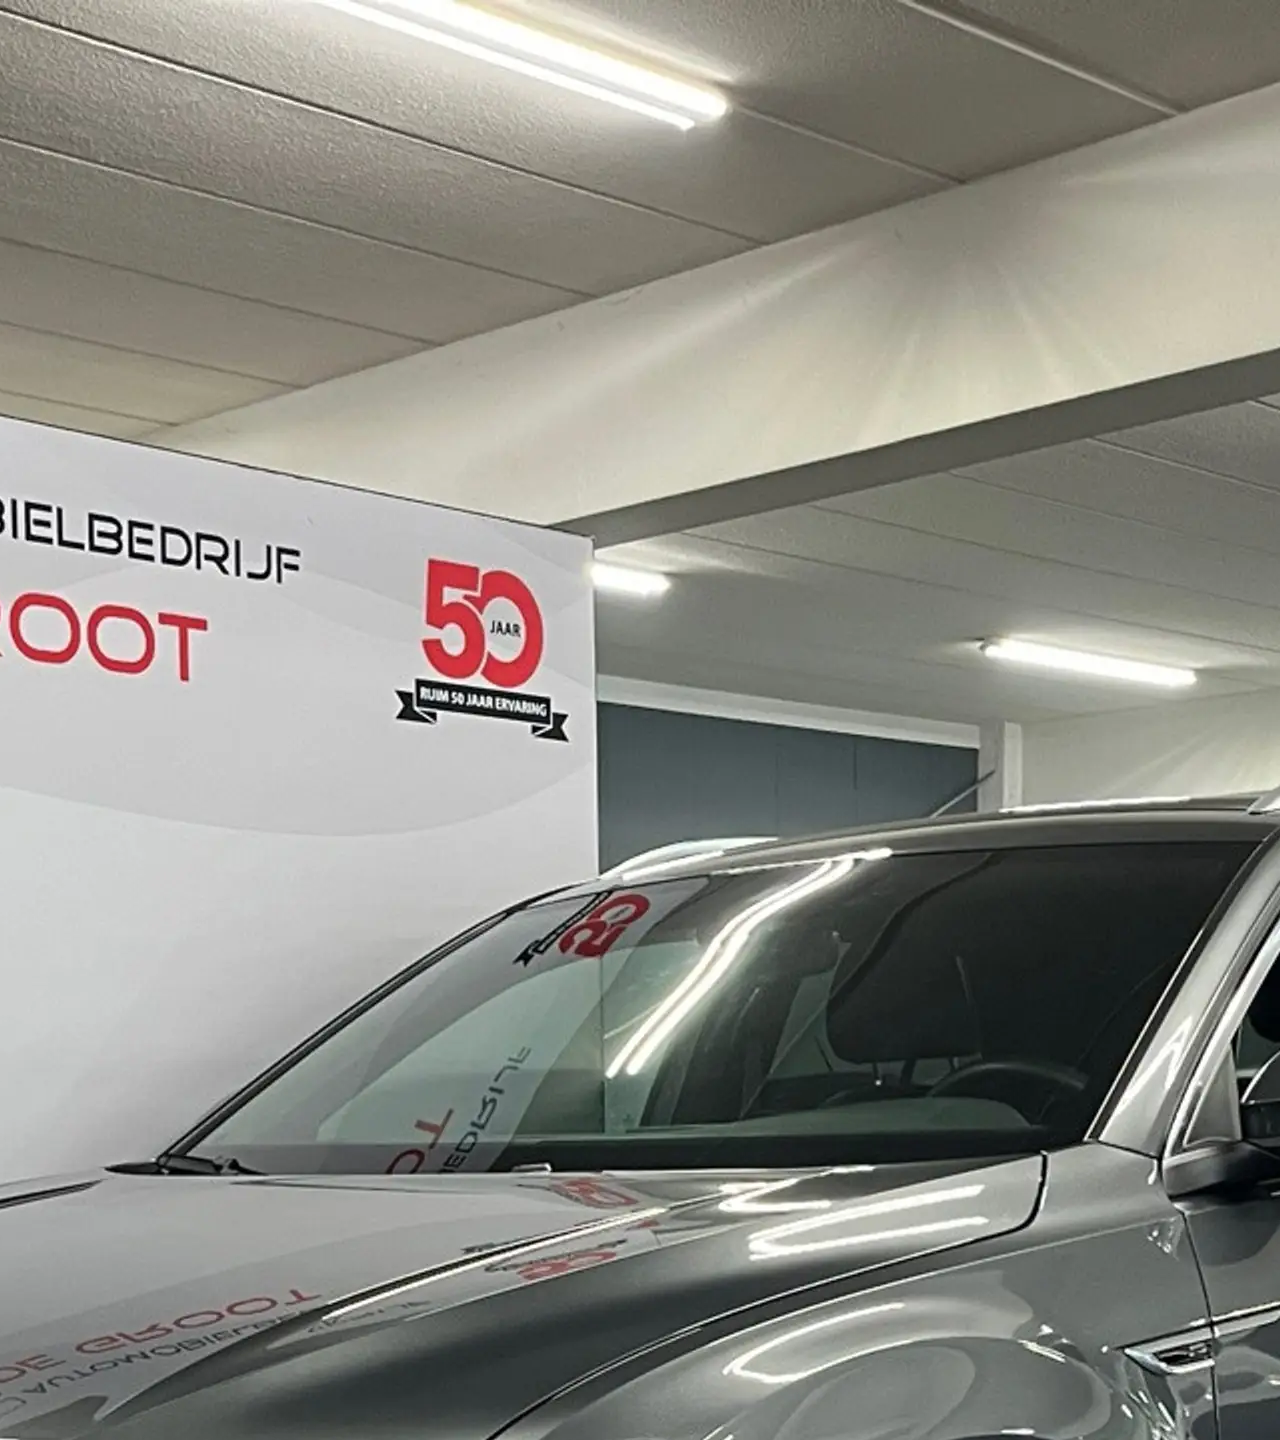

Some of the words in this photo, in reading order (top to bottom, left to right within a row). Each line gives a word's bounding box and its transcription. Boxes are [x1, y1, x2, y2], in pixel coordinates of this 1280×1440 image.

[421, 558, 544, 689] 50
[489, 620, 522, 637] JAAR
[420, 686, 449, 703] RUIM
[451, 689, 466, 704] 50
[466, 692, 493, 709] JAAR
[495, 696, 548, 717] ERVARING
